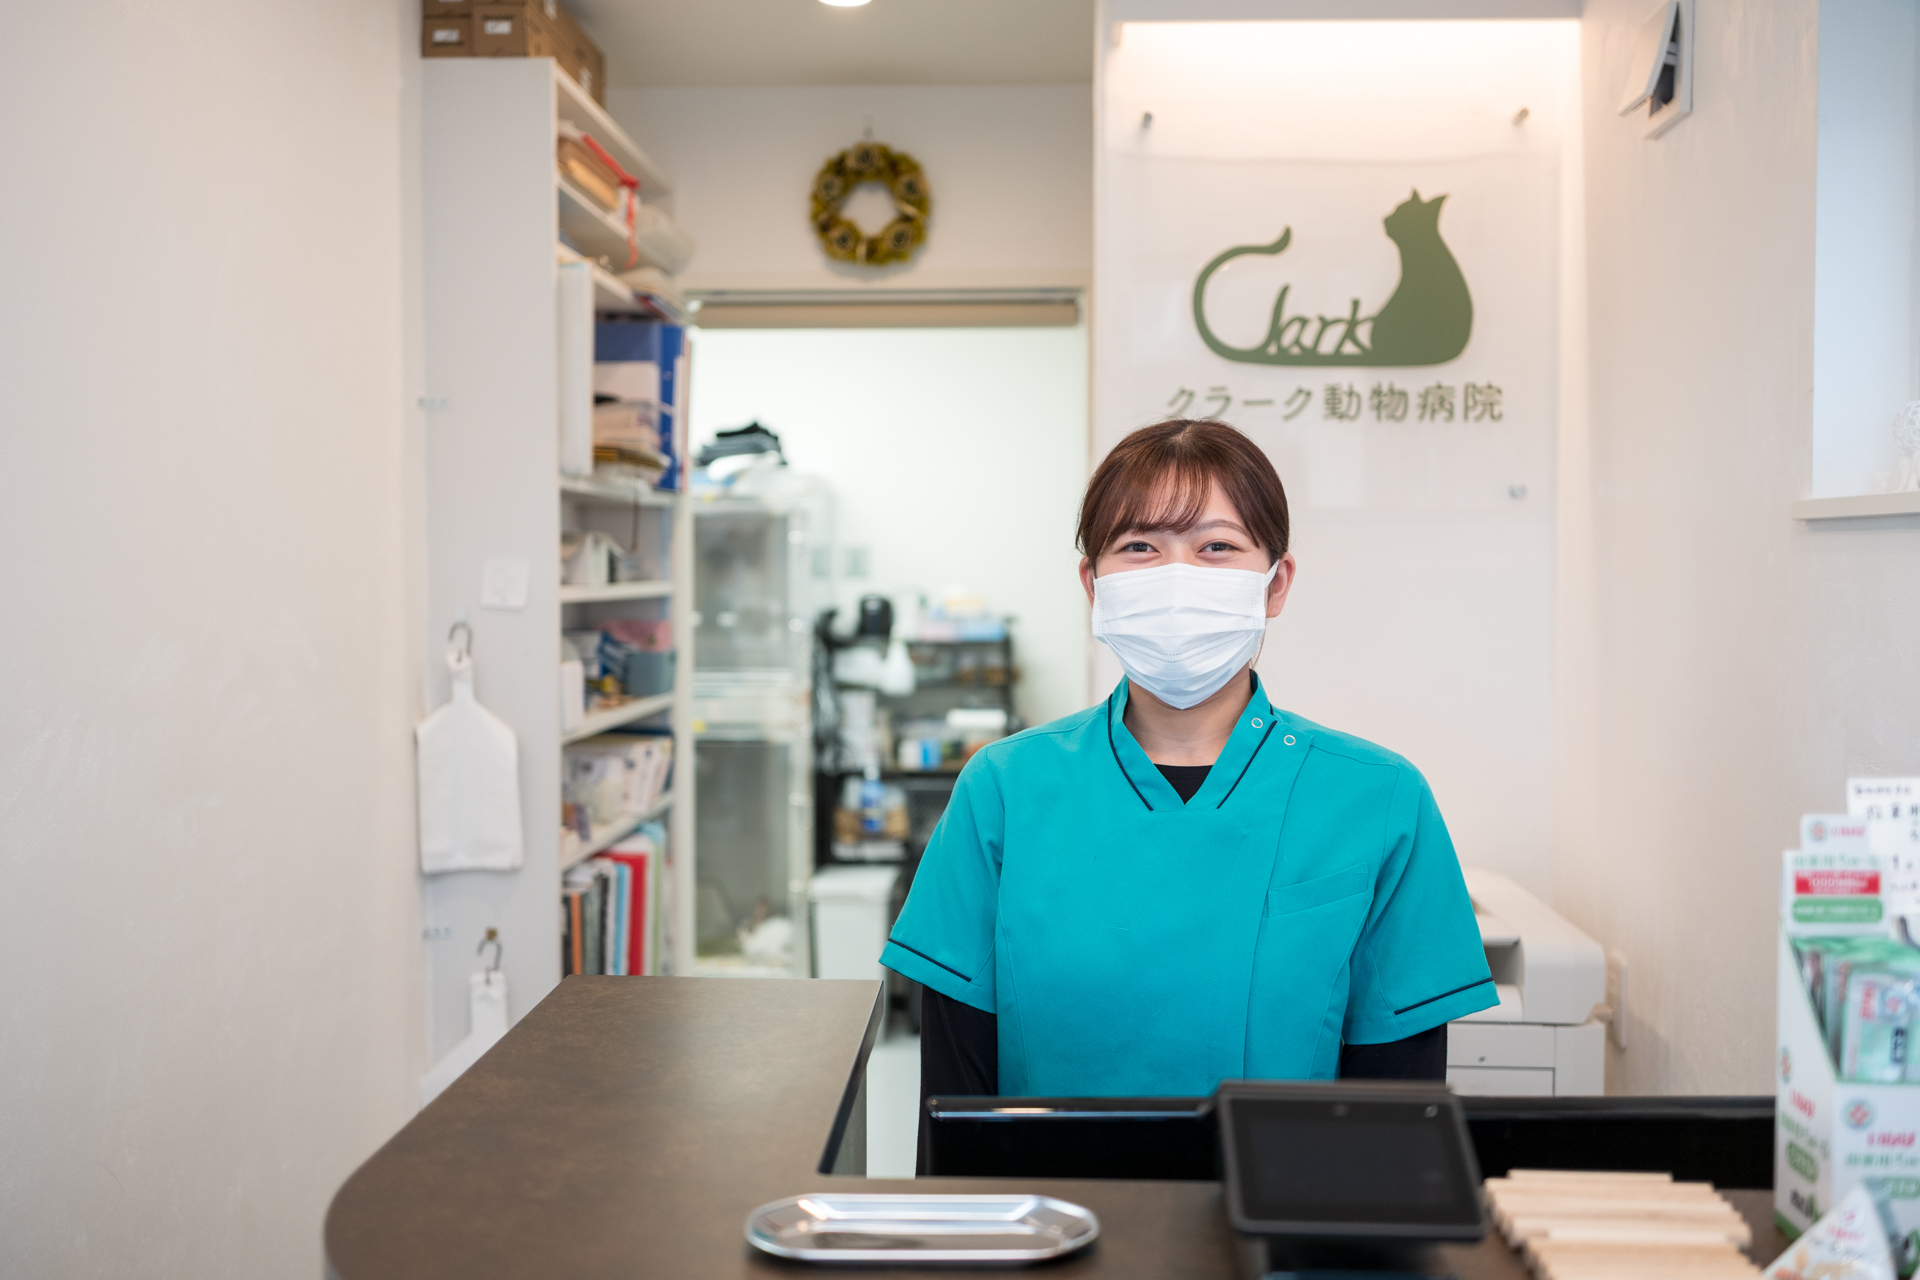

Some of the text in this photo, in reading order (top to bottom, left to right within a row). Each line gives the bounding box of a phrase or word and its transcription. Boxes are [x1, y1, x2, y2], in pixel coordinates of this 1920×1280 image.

[1193, 225, 1375, 366] Clark
[1166, 382, 1502, 421] クラーク動物病院
